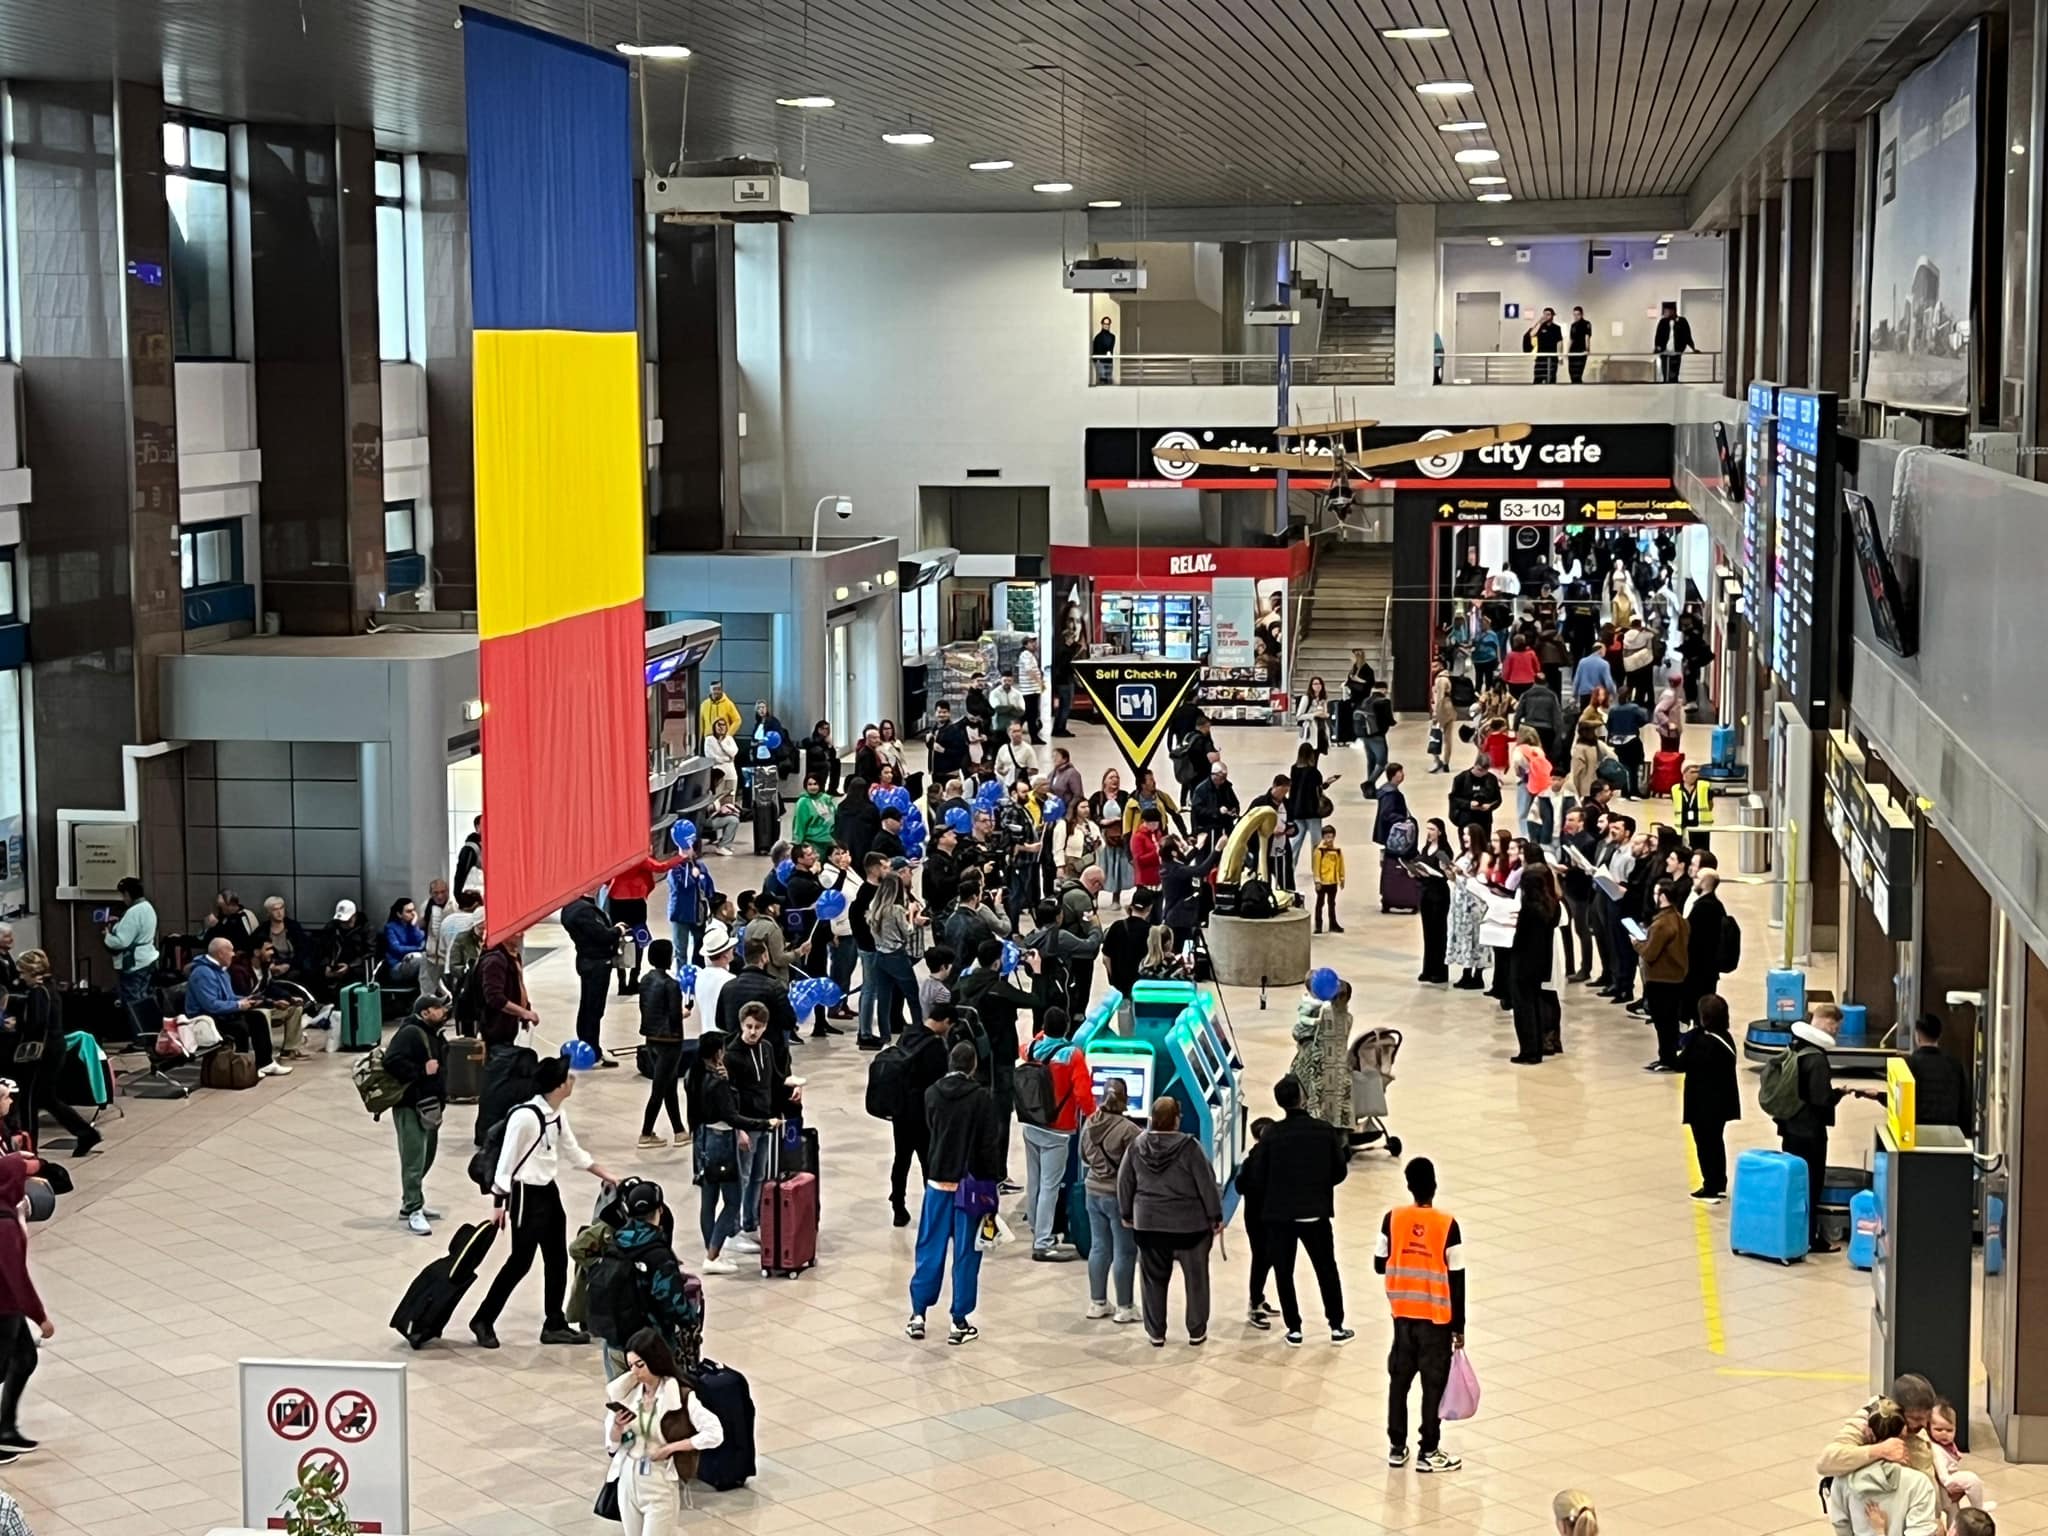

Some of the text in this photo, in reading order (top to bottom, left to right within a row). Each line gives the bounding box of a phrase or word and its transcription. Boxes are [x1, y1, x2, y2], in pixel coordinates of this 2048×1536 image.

[1478, 441, 1532, 471] city
[1539, 435, 1602, 463] cafe
[1503, 503, 1561, 517] 53-104
[1095, 668, 1120, 680] Self
